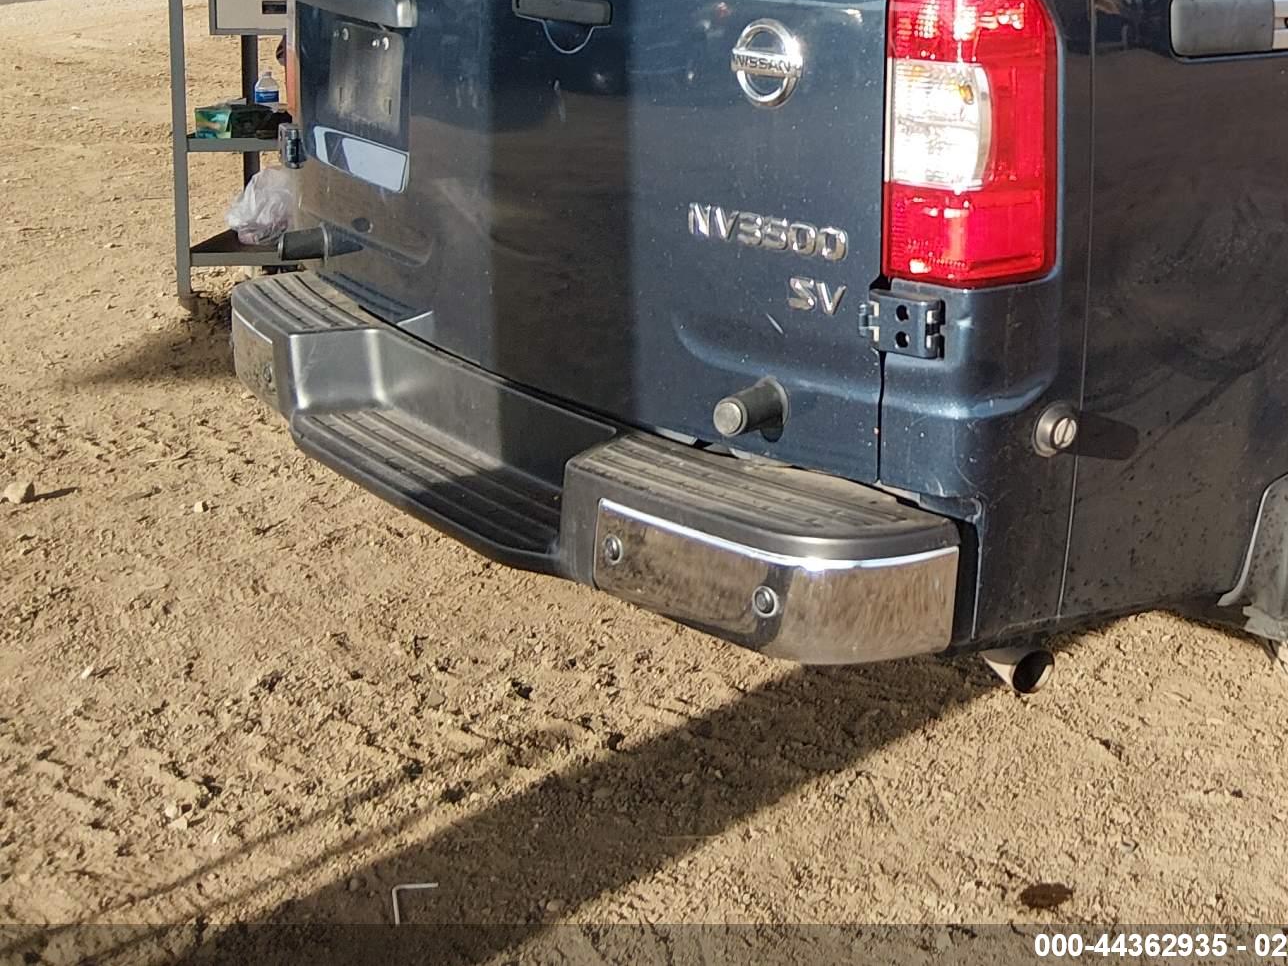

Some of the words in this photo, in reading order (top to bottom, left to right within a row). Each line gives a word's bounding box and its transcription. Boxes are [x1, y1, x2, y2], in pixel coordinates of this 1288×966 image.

[736, 54, 792, 73] NISSAN
[688, 202, 848, 261] NV3500
[788, 276, 847, 315] SV
